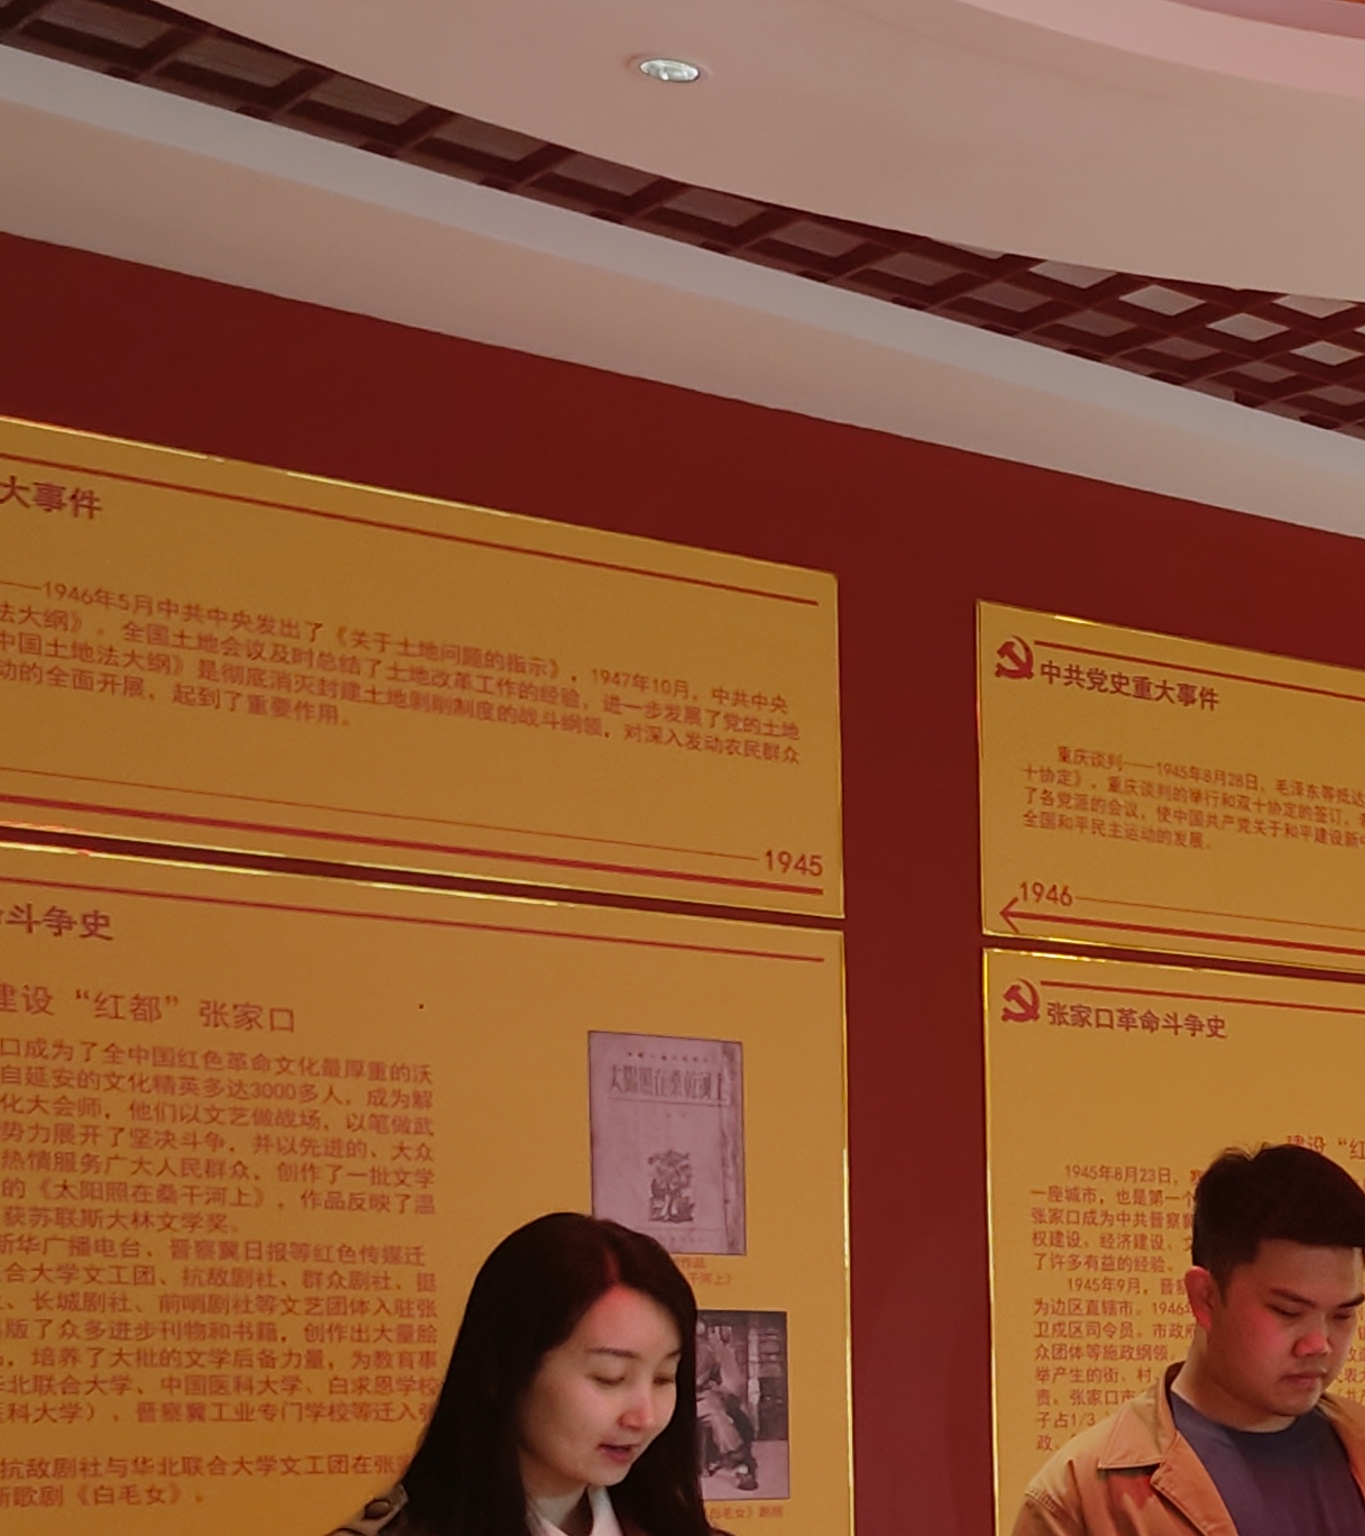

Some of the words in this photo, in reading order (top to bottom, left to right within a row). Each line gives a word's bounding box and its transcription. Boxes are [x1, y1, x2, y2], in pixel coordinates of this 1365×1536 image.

[0, 475, 102, 520] 大事件
[1039, 660, 1220, 711] 中共党史重大事件
[763, 849, 824, 878] 1945
[1019, 881, 1073, 908] 1946
[0, 902, 114, 941] 斗争史
[1047, 1000, 1228, 1039] 张家口革命斗争史
[0, 1263, 437, 1293] 合大学文工团、抗敌剧社、群众剧社、挺
[0, 1291, 438, 1319] 、长城剧社、前哨剧社等文艺团体入驻张
[0, 1318, 438, 1345] 版了众多进步刊物和书籍，创作出大量脍
[0, 1374, 440, 1397] 北联合大学、中国医科大学、白求恩学校
